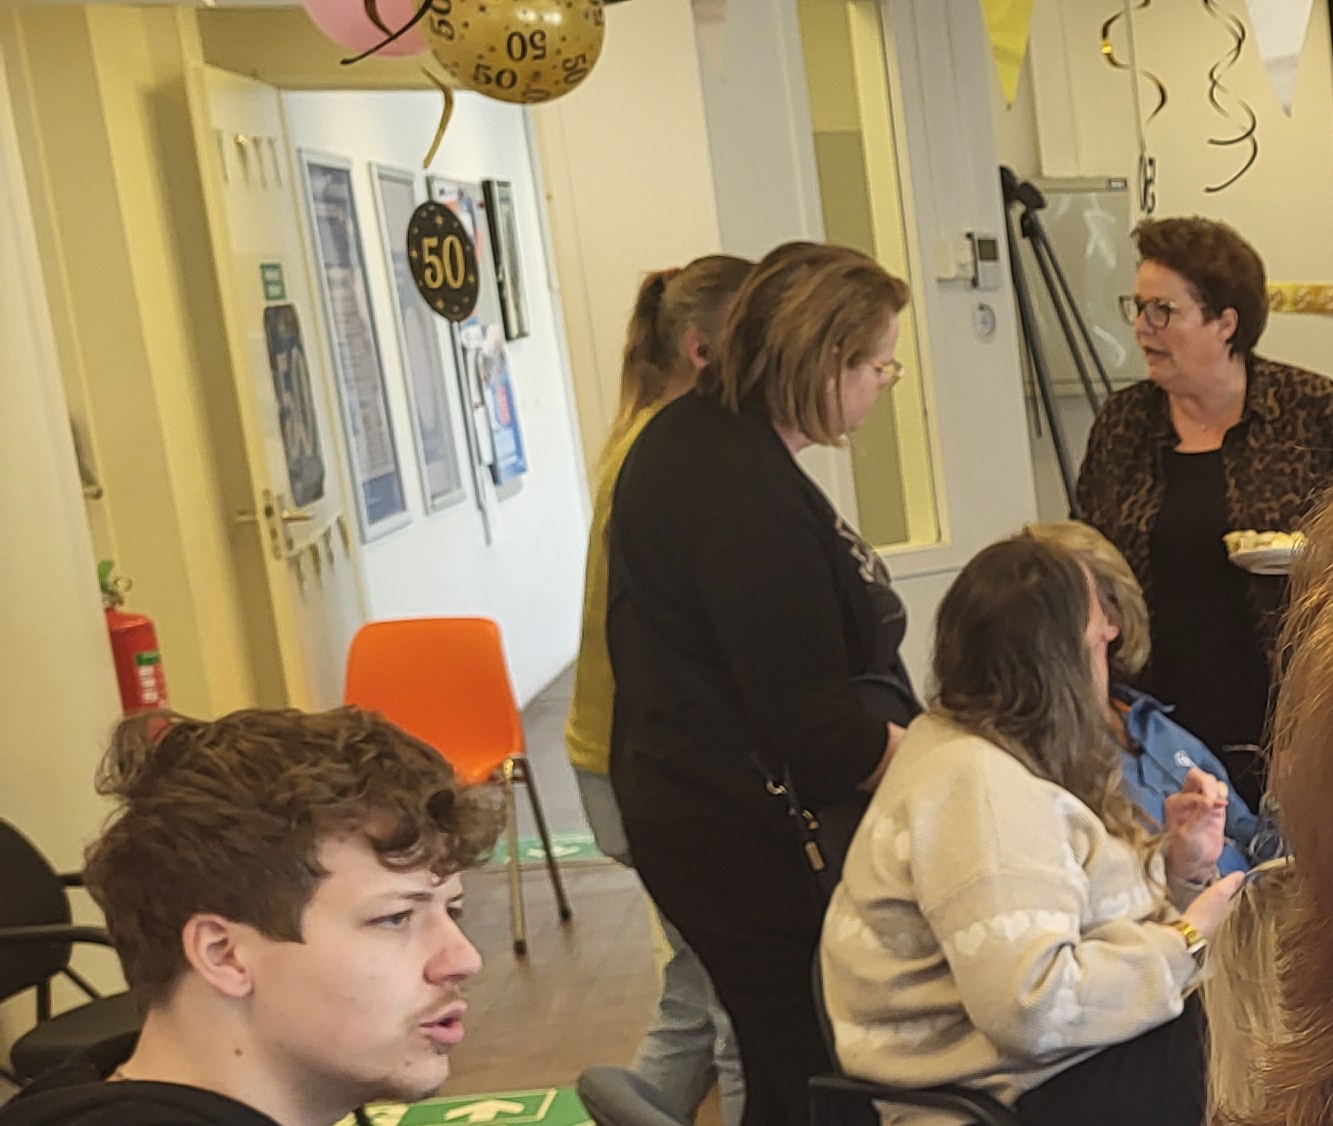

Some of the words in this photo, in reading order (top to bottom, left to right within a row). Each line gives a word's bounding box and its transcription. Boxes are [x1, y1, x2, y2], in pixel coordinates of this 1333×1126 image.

[506, 29, 547, 62] 50
[473, 63, 518, 89] 50
[422, 234, 466, 289] 50
